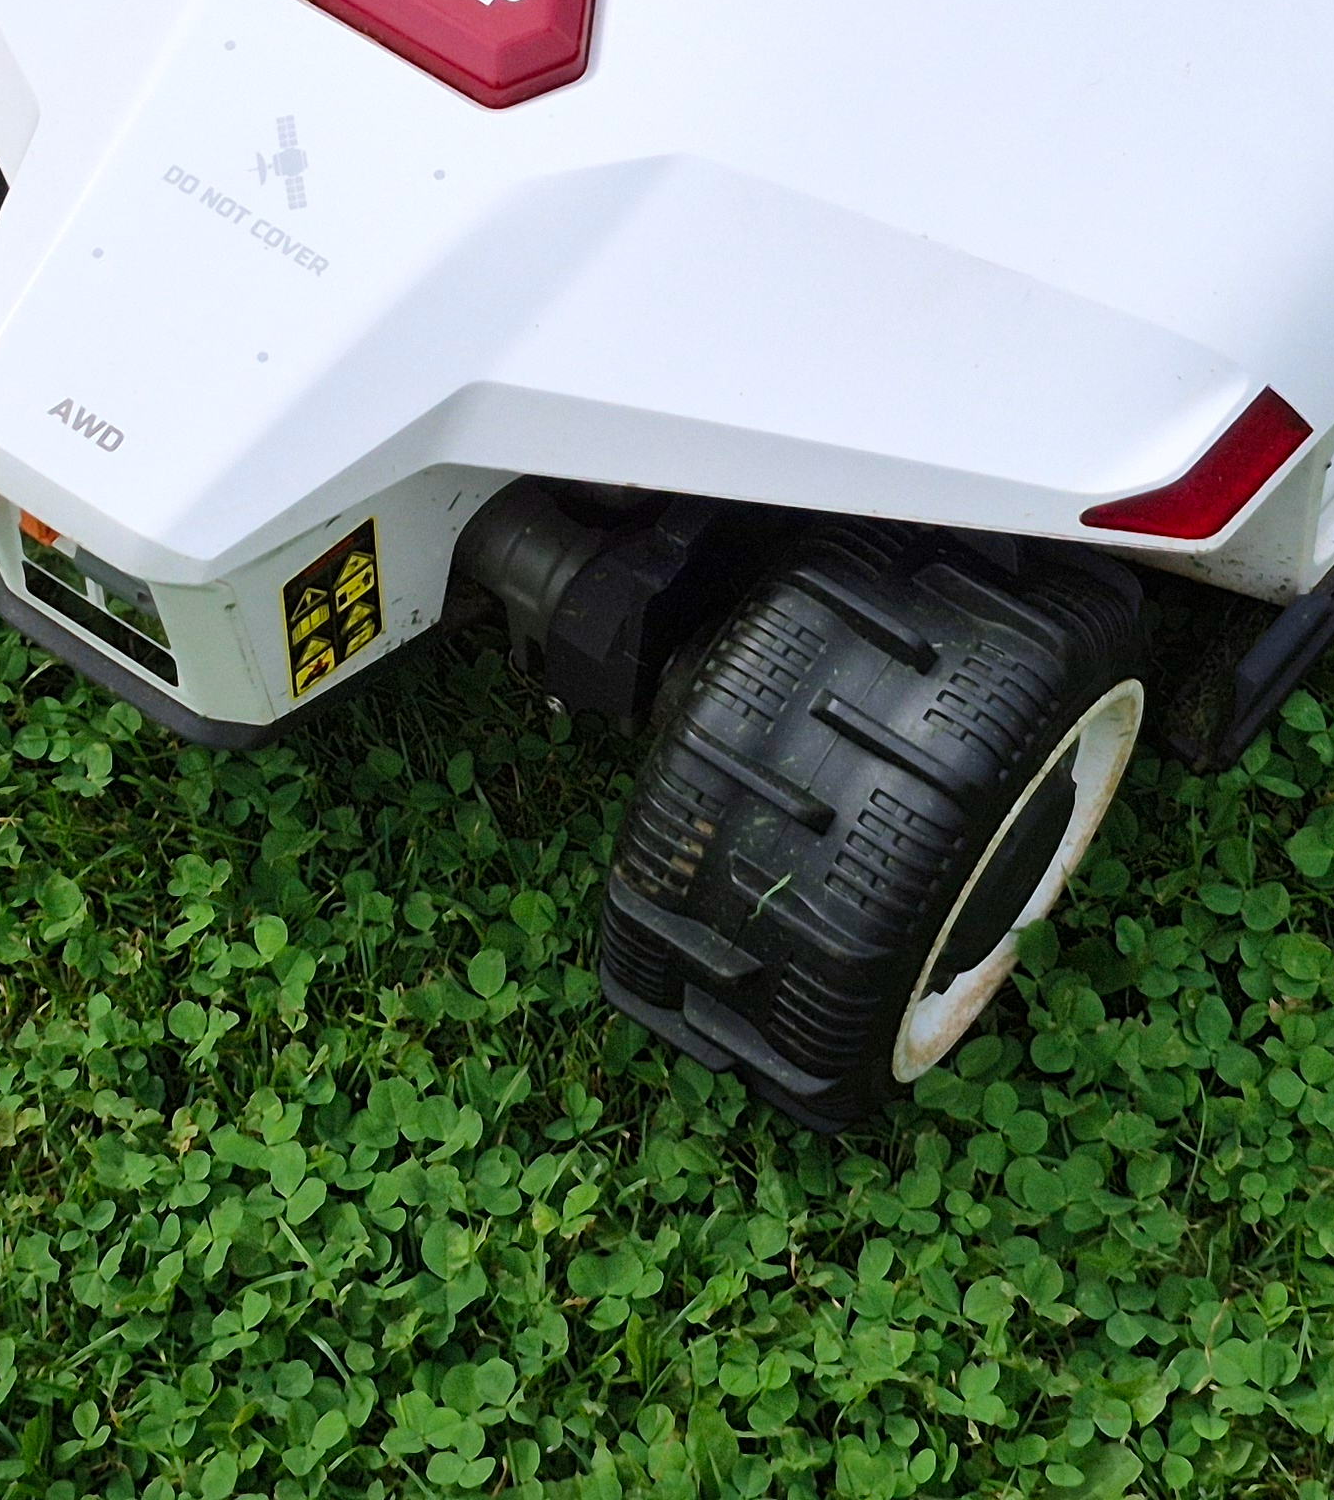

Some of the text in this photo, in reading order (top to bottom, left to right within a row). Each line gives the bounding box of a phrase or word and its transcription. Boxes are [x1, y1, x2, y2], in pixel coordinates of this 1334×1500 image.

[162, 164, 329, 277] DO NOT COVER
[47, 397, 125, 453] AWD
